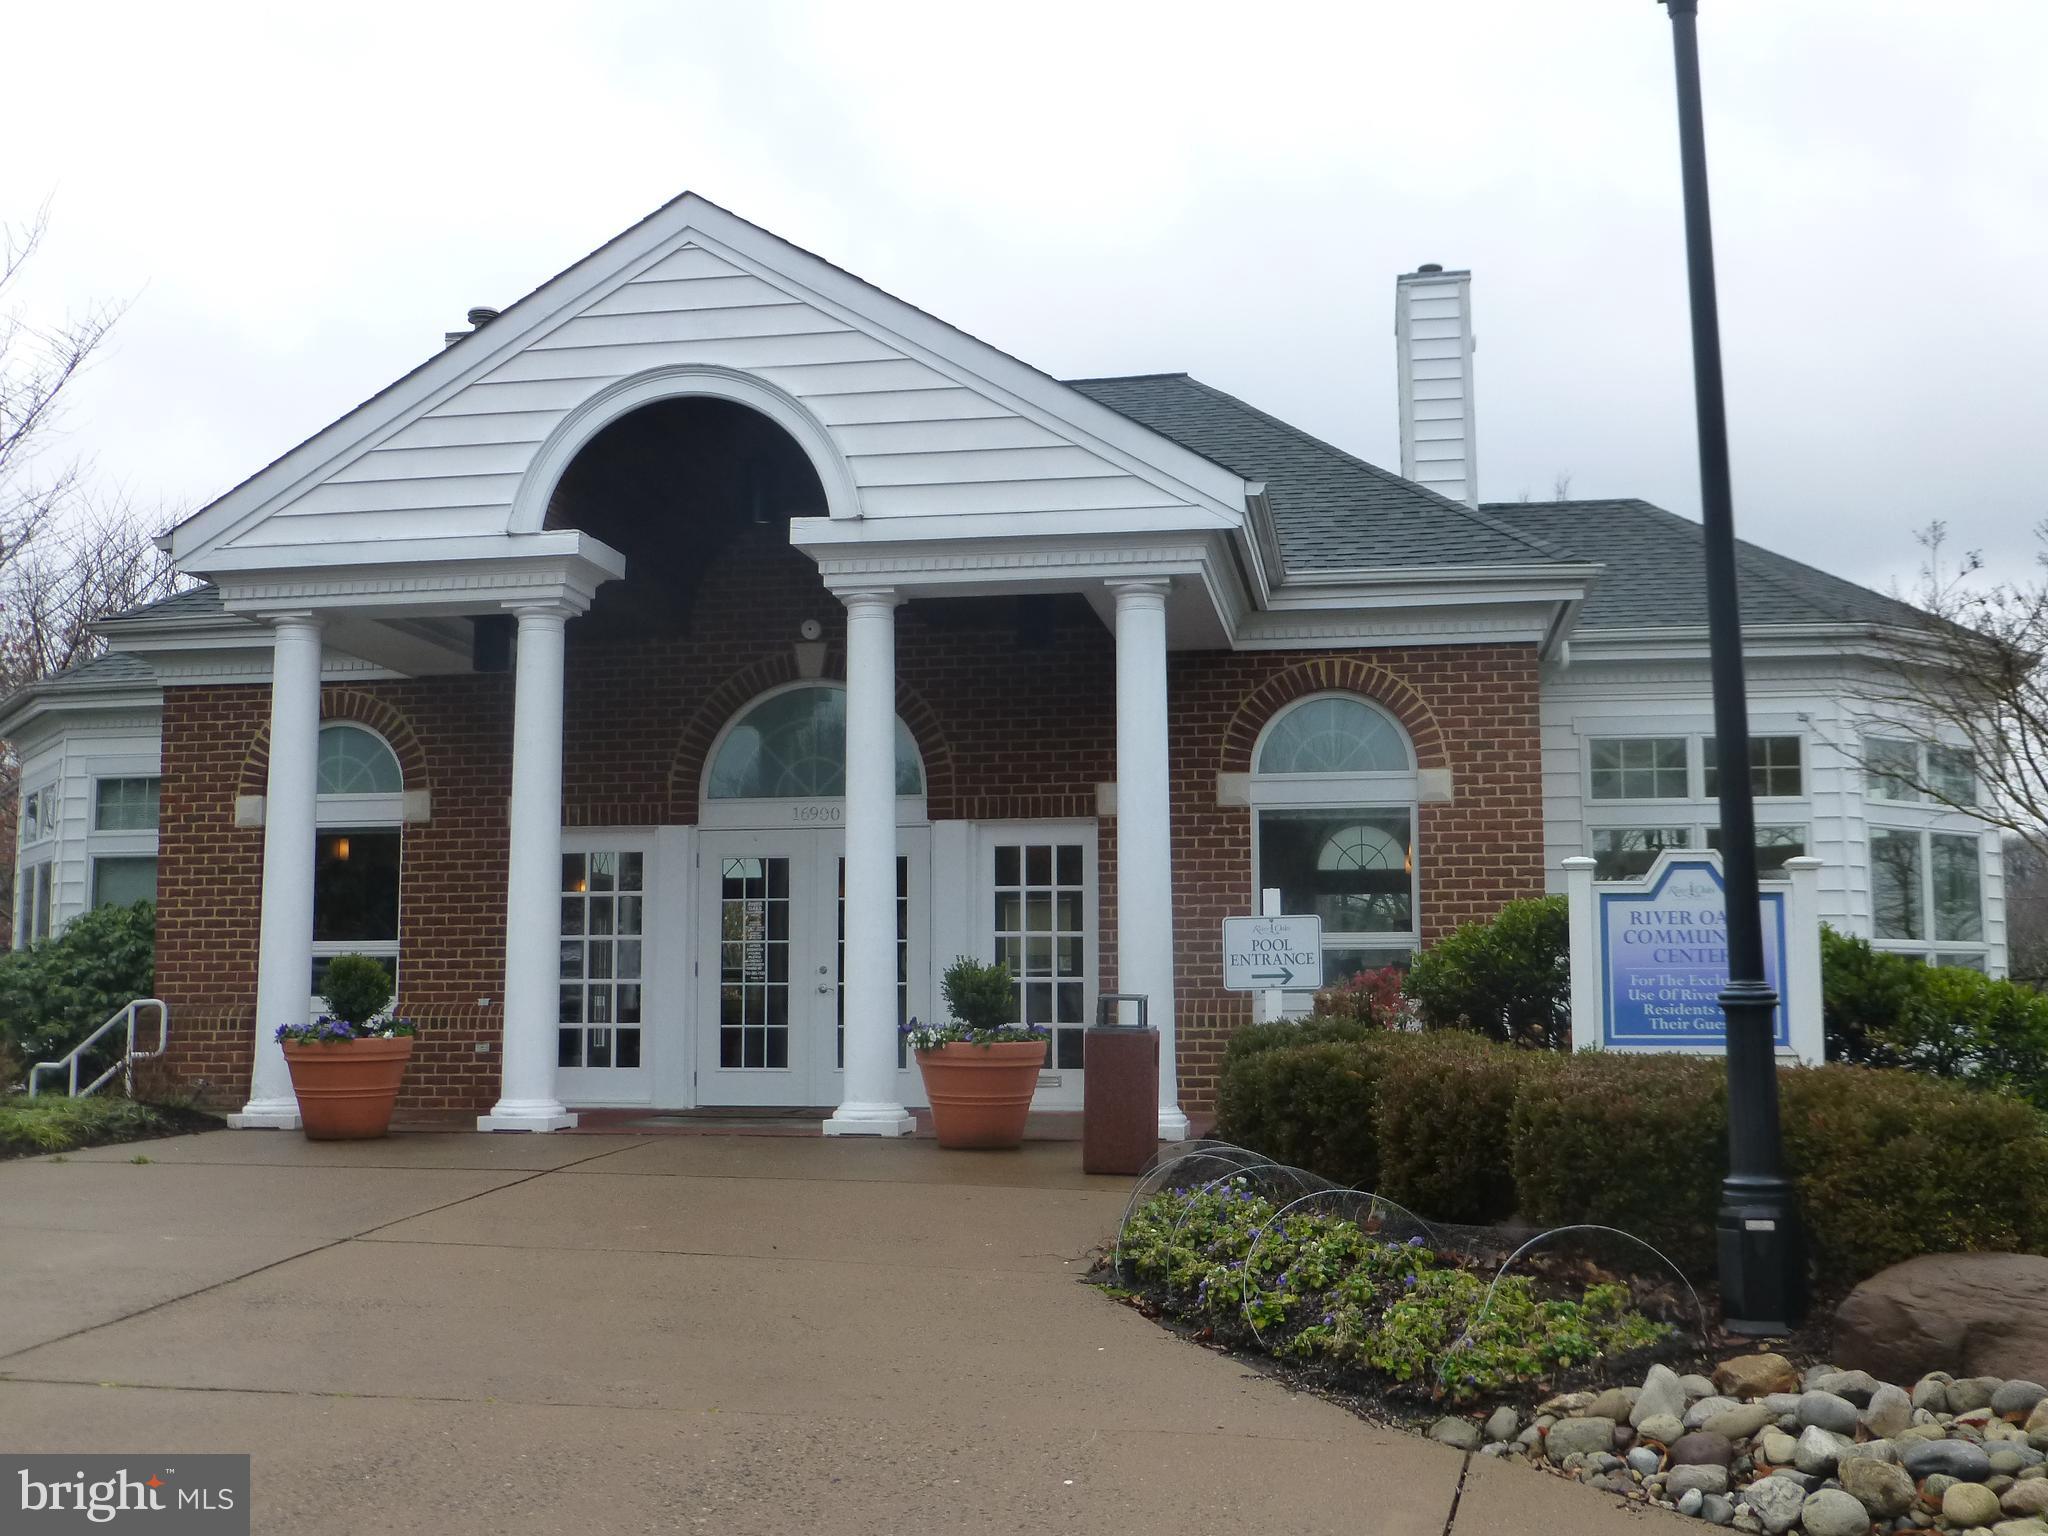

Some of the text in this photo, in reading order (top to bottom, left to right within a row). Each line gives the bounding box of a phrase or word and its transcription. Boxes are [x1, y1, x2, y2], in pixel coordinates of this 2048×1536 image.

[792, 806, 841, 821] 16900
[1630, 910, 1727, 925] RIVER OA
[1623, 929, 1728, 944] COMMUN
[1251, 939, 1293, 951] POOL
[1230, 953, 1315, 966] ENTRANCE
[1631, 974, 1729, 986] For The Exclu
[1628, 989, 1655, 1000] Use
[1659, 988, 1679, 1000] Of
[1644, 1003, 1716, 1015] Residents
[1649, 1017, 1690, 1029] Their
